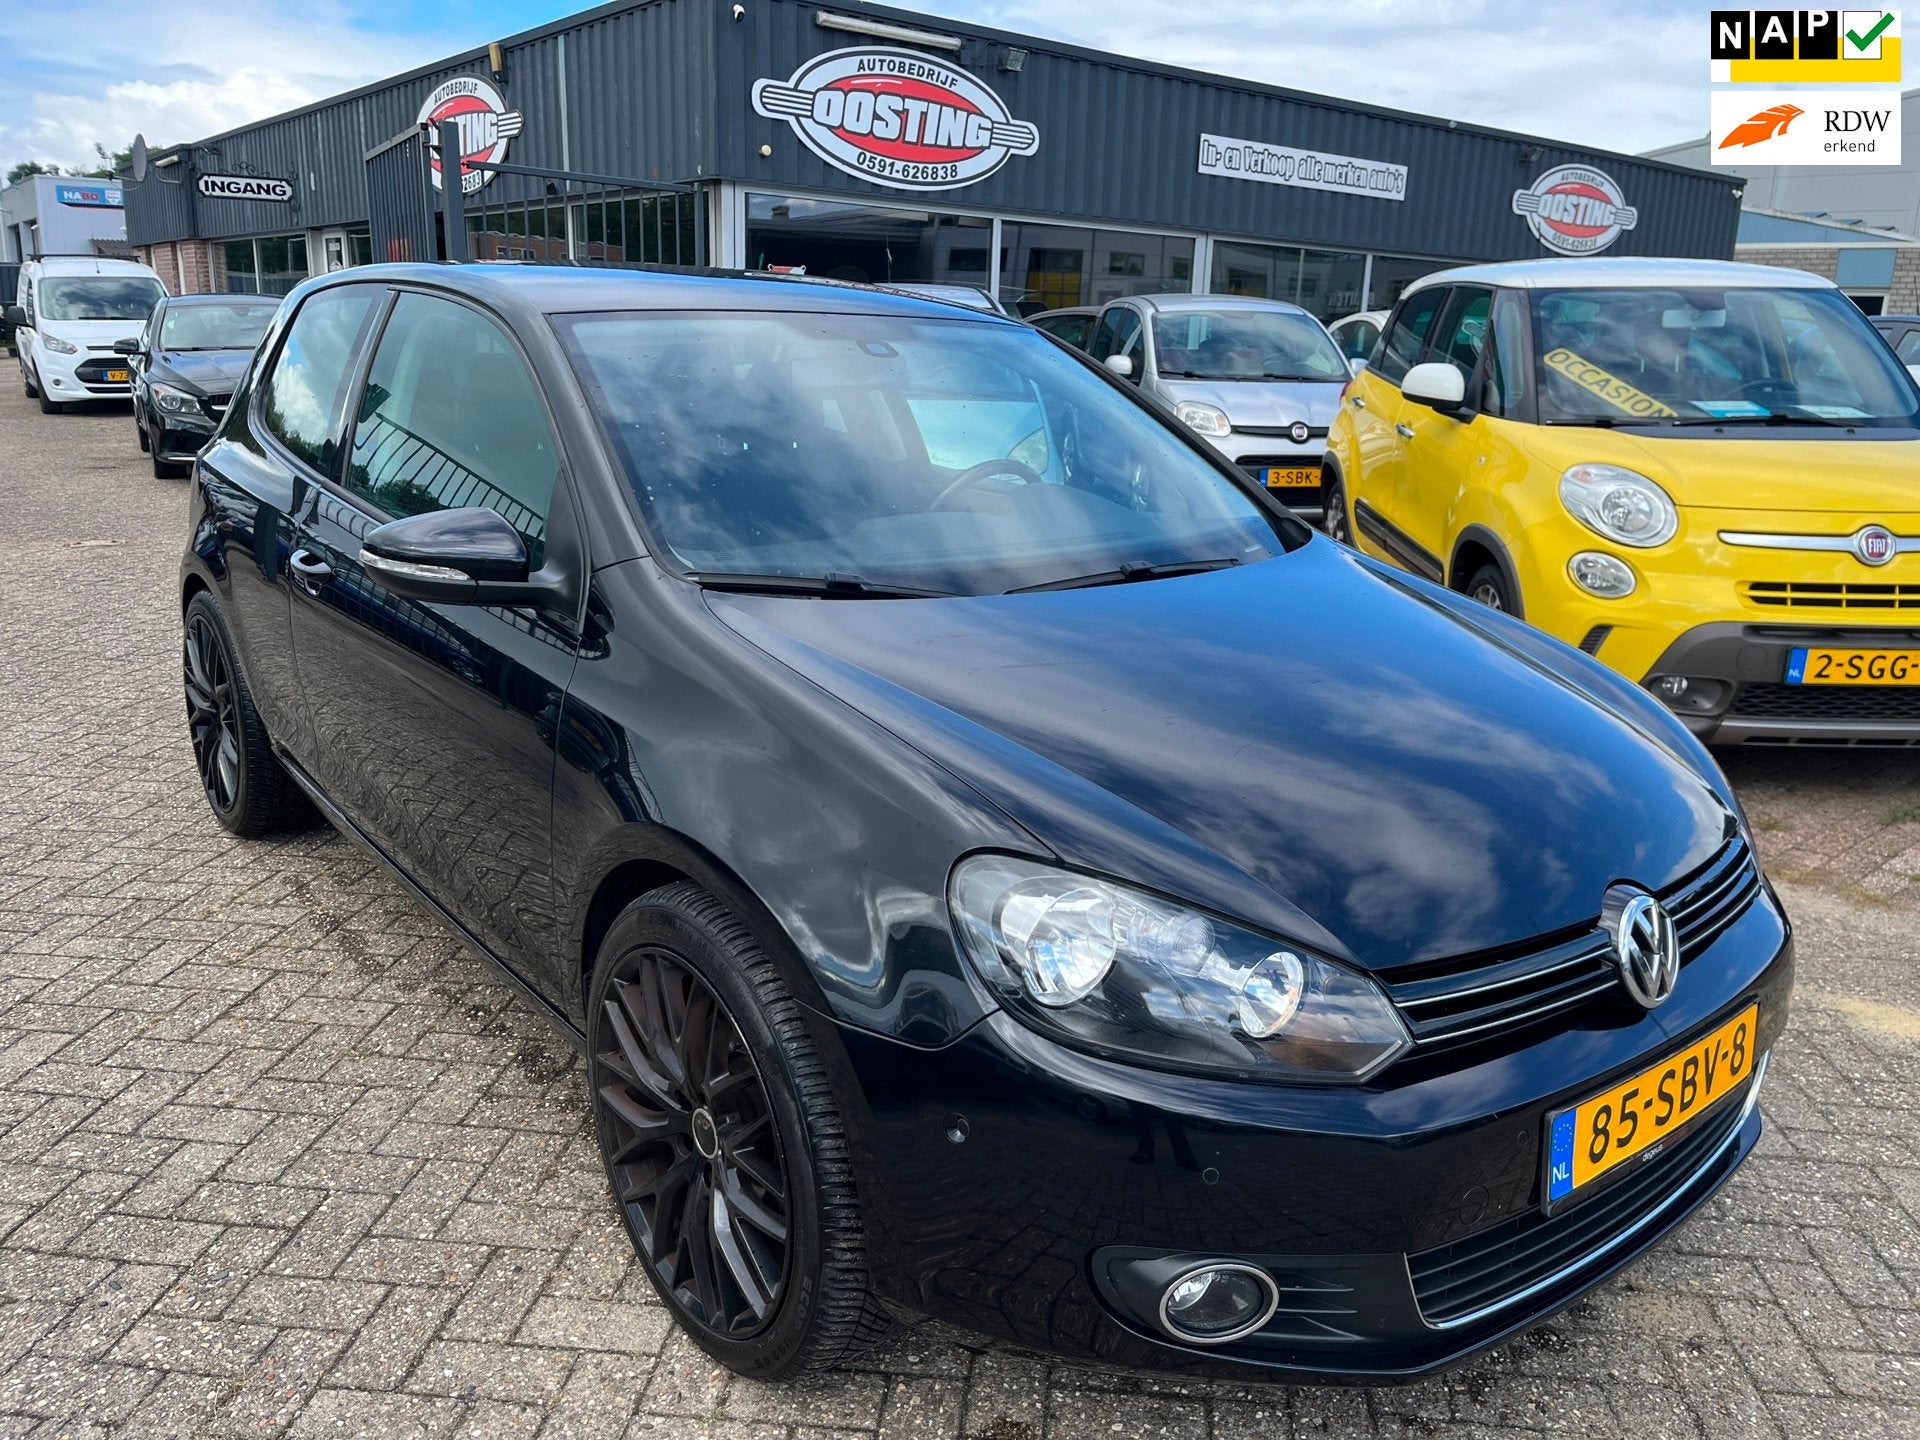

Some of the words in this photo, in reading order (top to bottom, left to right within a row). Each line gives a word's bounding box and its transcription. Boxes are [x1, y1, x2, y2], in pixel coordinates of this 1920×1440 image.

[856, 58, 959, 89] AUTOBEDRIJF
[433, 81, 478, 105] AUTOBEDRIJF
[812, 89, 993, 150] OOSTING
[856, 152, 958, 181] 0591-626838
[1202, 140, 1222, 167] In-
[1224, 147, 1241, 171] en
[1243, 146, 1295, 181] Verkoop
[1298, 156, 1323, 182] alle
[1323, 162, 1369, 189] merken
[1369, 167, 1405, 193] auto's
[203, 180, 287, 197] INGANG
[1538, 193, 1618, 228] OOSTING
[1272, 471, 1321, 484] 3-SBK-
[1868, 537, 1887, 554] FIAT
[1788, 668, 1801, 678] NL
[1813, 654, 1920, 680] 2-SGG-
[1588, 1022, 1747, 1164] 85-SBV-8
[1552, 1163, 1570, 1185] NL
